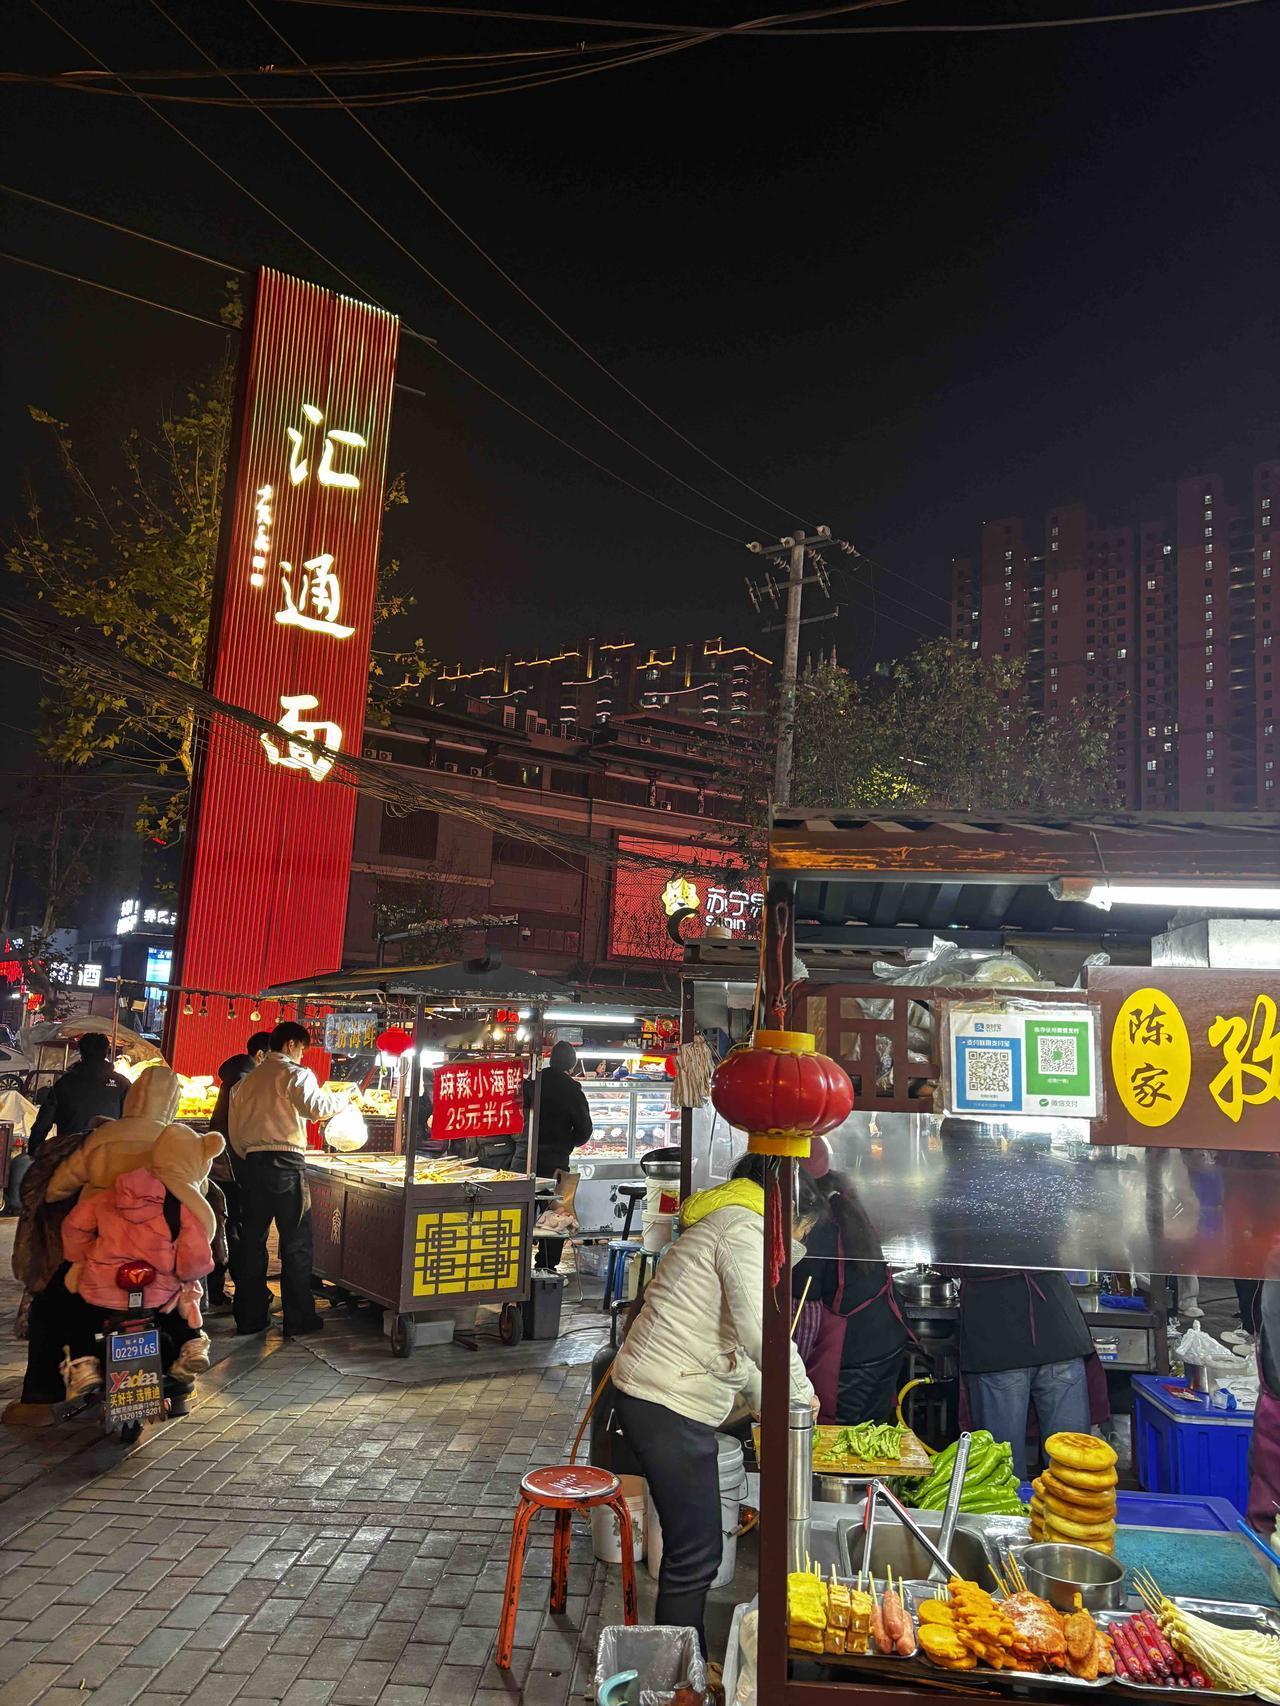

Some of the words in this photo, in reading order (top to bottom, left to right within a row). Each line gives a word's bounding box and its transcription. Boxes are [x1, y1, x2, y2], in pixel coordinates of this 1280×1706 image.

[260, 403, 367, 784] 汇通面
[1128, 1003, 1173, 1108] 陈家
[440, 1068, 522, 1100] 麻辣小海鲜
[444, 1100, 514, 1131] 25元半斤
[115, 1343, 156, 1359] 0229165
[110, 1369, 160, 1393] Yadea
